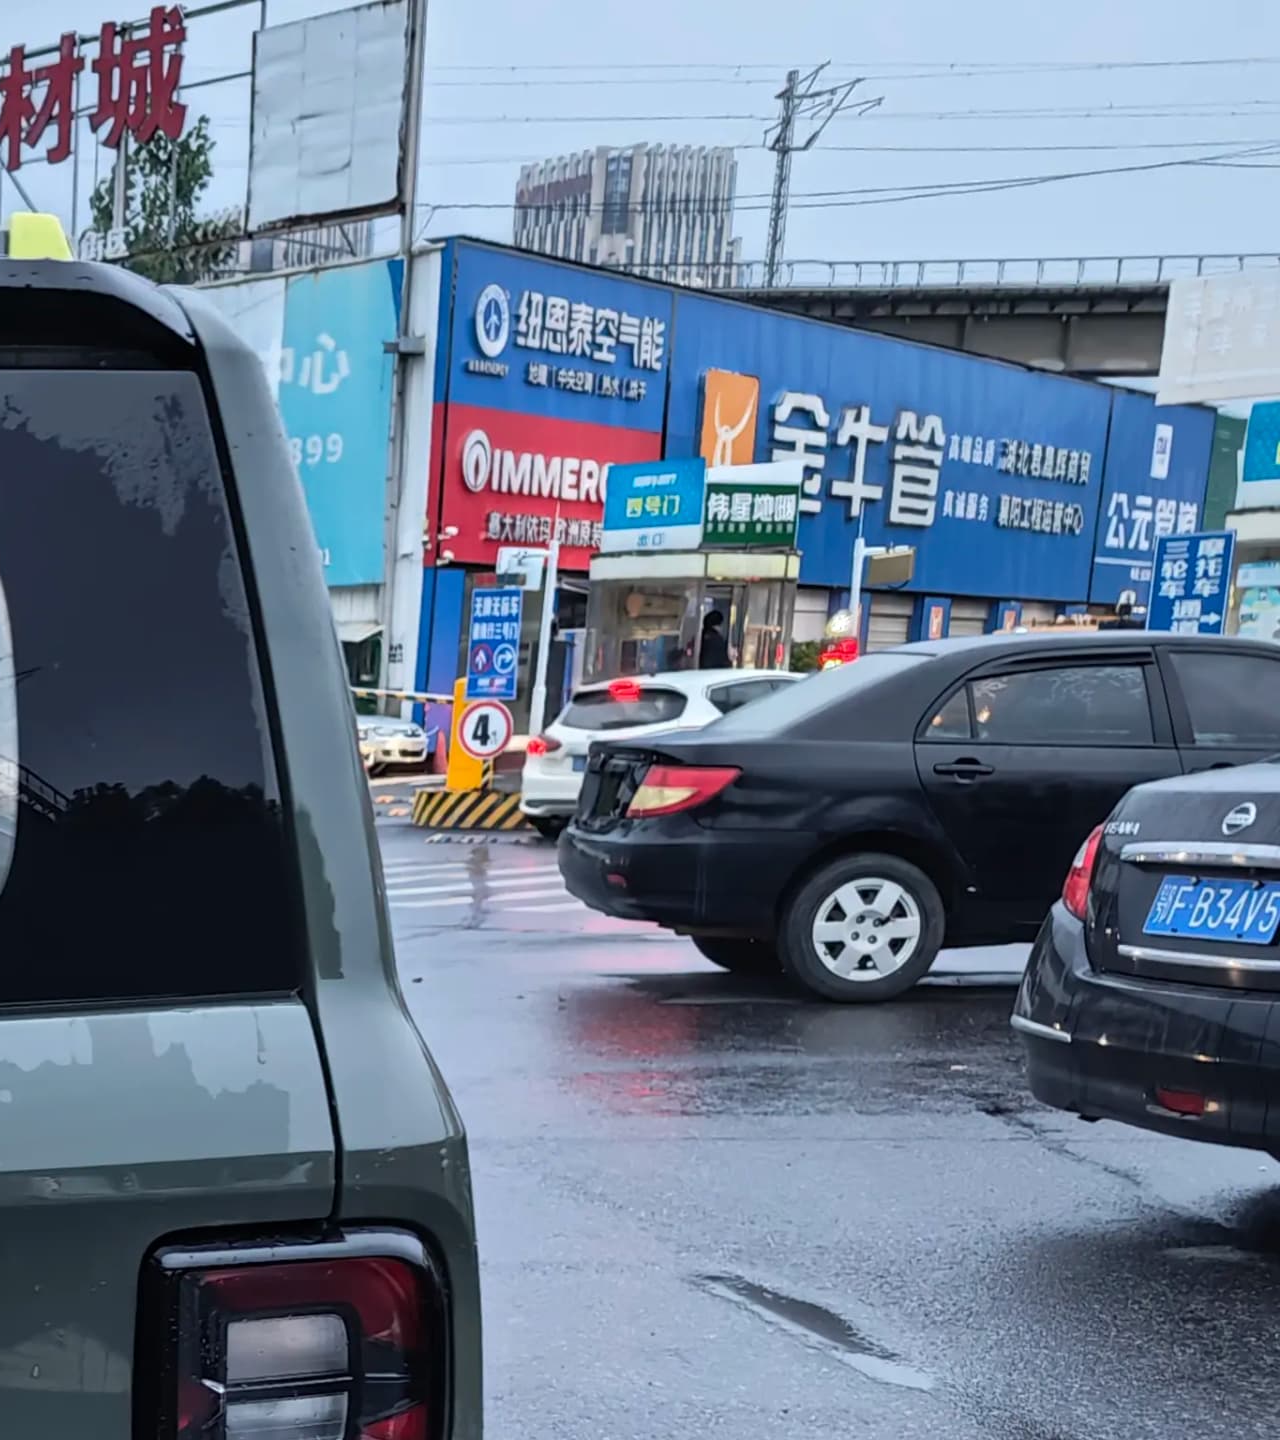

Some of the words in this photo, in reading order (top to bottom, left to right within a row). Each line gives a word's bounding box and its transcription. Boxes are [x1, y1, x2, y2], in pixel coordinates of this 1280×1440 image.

[517, 290, 666, 371] 纽恩泰空气能
[491, 448, 608, 503] IMMER
[771, 390, 947, 528] 金牛管
[626, 494, 681, 519] 四号门
[1158, 540, 1191, 599] 三轮车
[1193, 538, 1227, 598] 摩托车
[472, 713, 491, 747] 4
